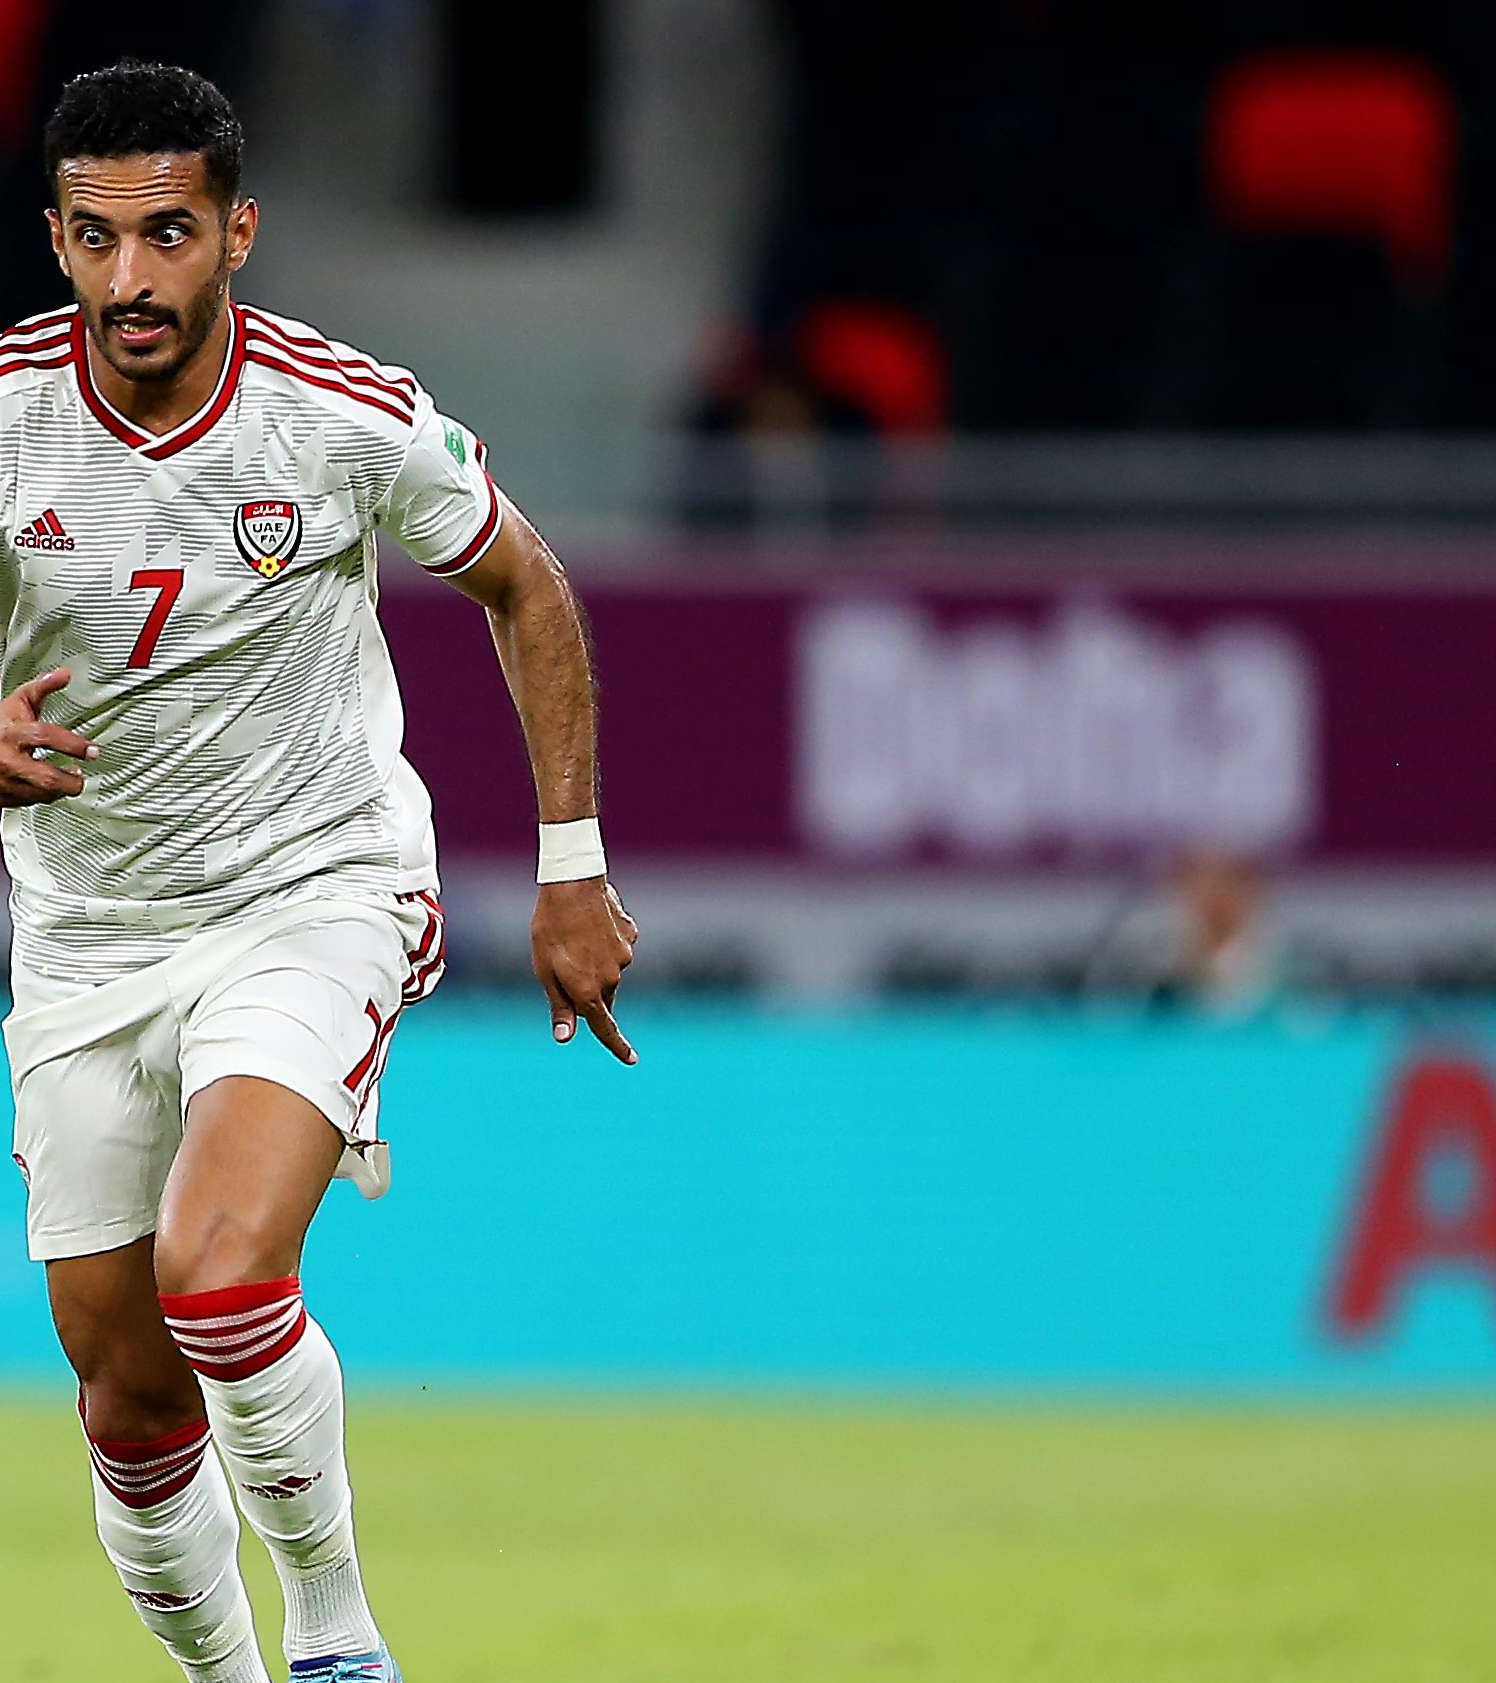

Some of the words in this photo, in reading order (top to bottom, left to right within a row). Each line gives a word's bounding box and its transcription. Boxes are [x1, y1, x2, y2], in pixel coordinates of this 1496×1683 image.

[252, 522, 284, 533] UAE
[14, 534, 75, 551] adidas
[260, 534, 277, 544] FA
[126, 568, 185, 669] 7
